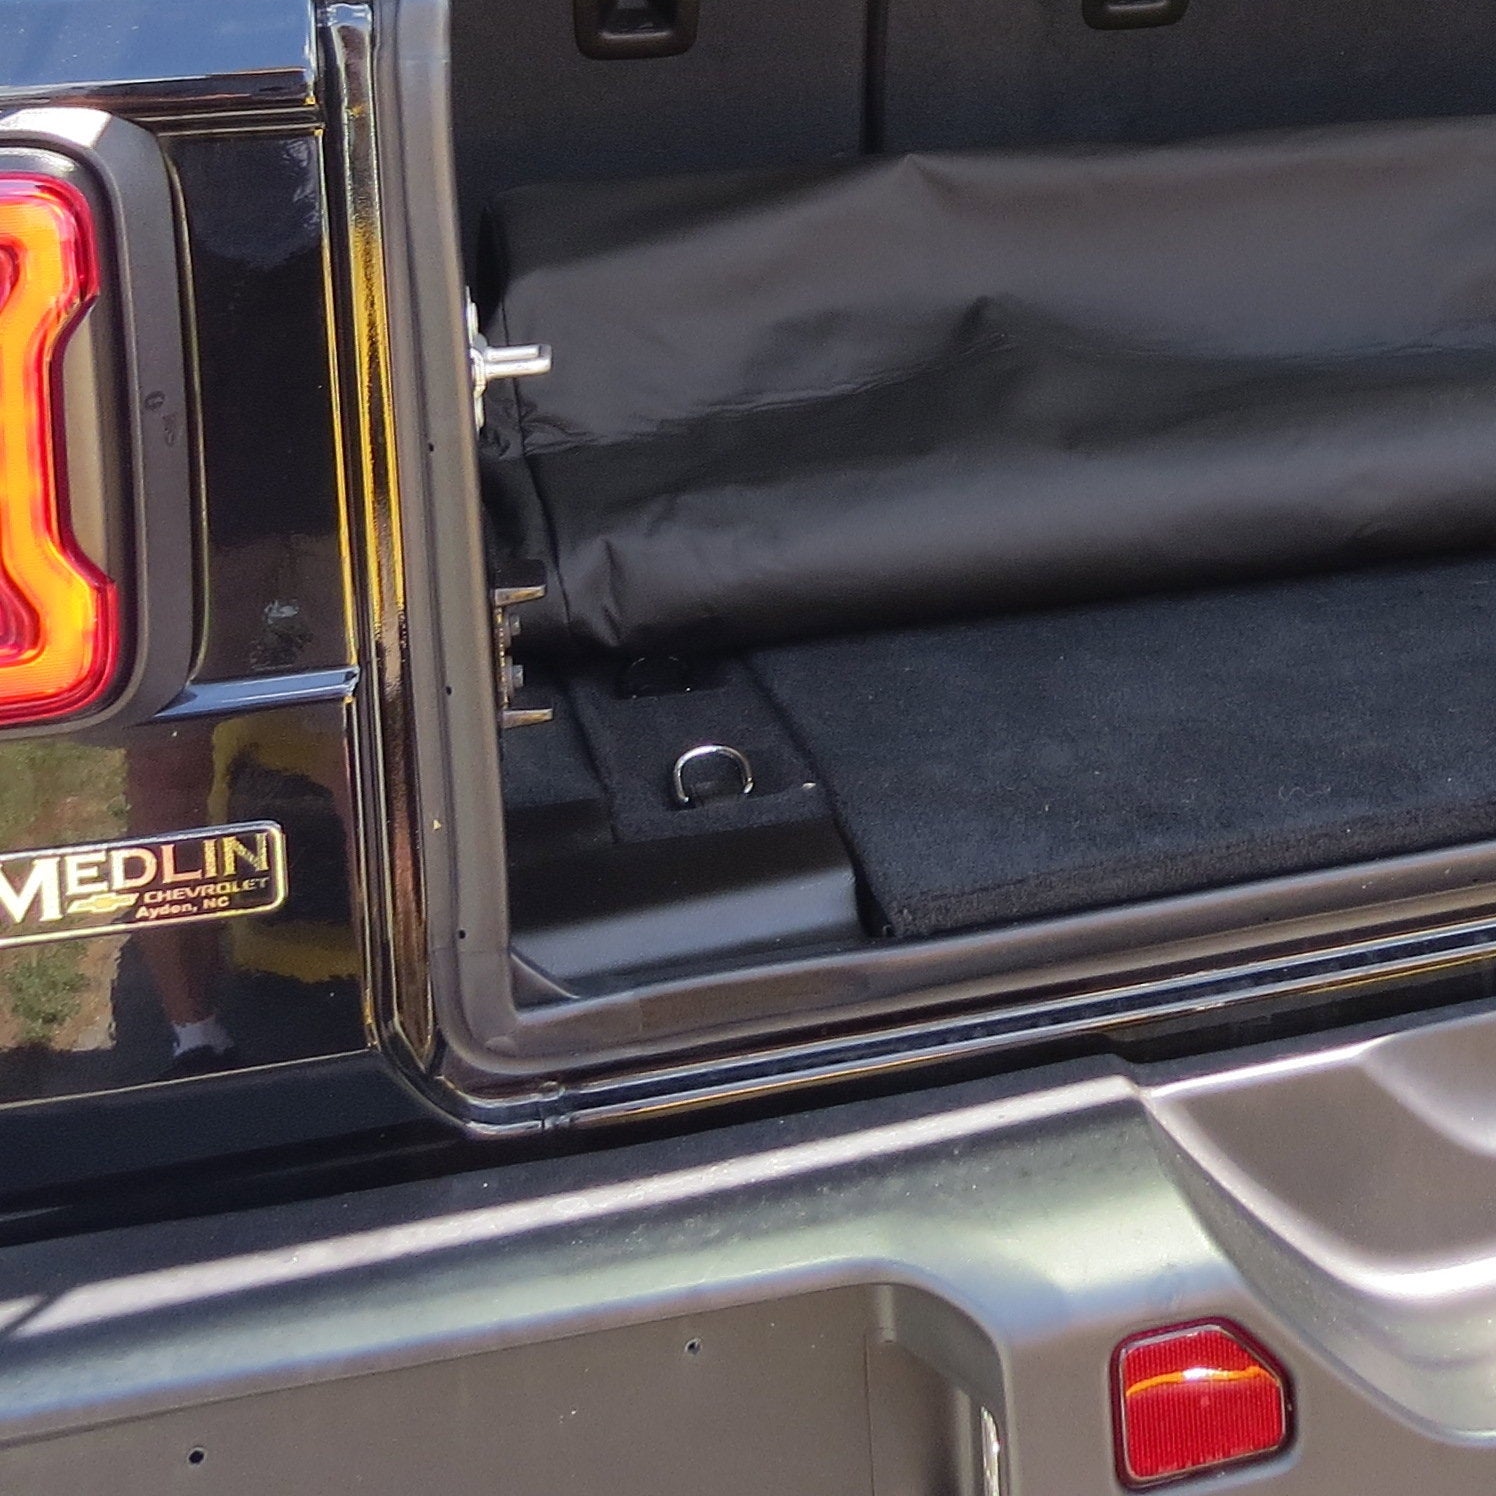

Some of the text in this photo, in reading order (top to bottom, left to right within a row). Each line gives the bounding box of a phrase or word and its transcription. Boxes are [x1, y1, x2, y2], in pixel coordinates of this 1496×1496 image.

[0, 834, 269, 922] MEDLIN
[144, 877, 269, 903] CHEVROLET
[135, 897, 229, 920] Ayden, NC
